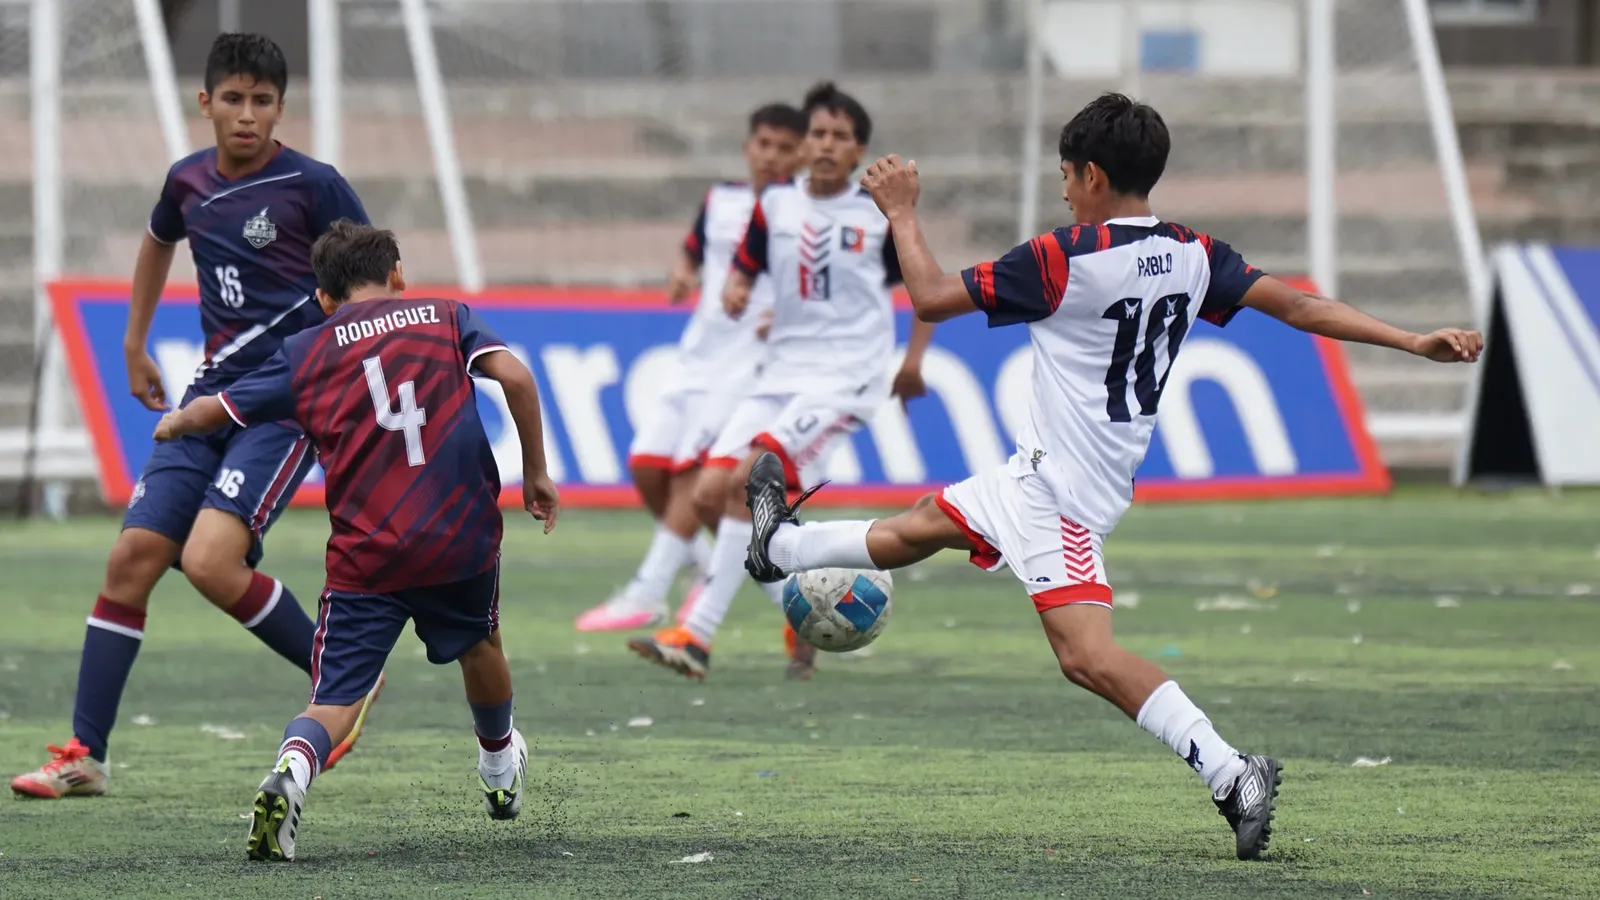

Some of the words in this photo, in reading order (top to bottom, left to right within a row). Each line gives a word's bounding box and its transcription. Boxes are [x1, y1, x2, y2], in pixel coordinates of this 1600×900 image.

[1137, 252, 1172, 277] PABLO
[215, 265, 245, 308] 16
[334, 305, 441, 347] RODRIGUEZ
[1101, 292, 1191, 422] 10
[362, 355, 426, 467] 4
[215, 468, 246, 499] 16
